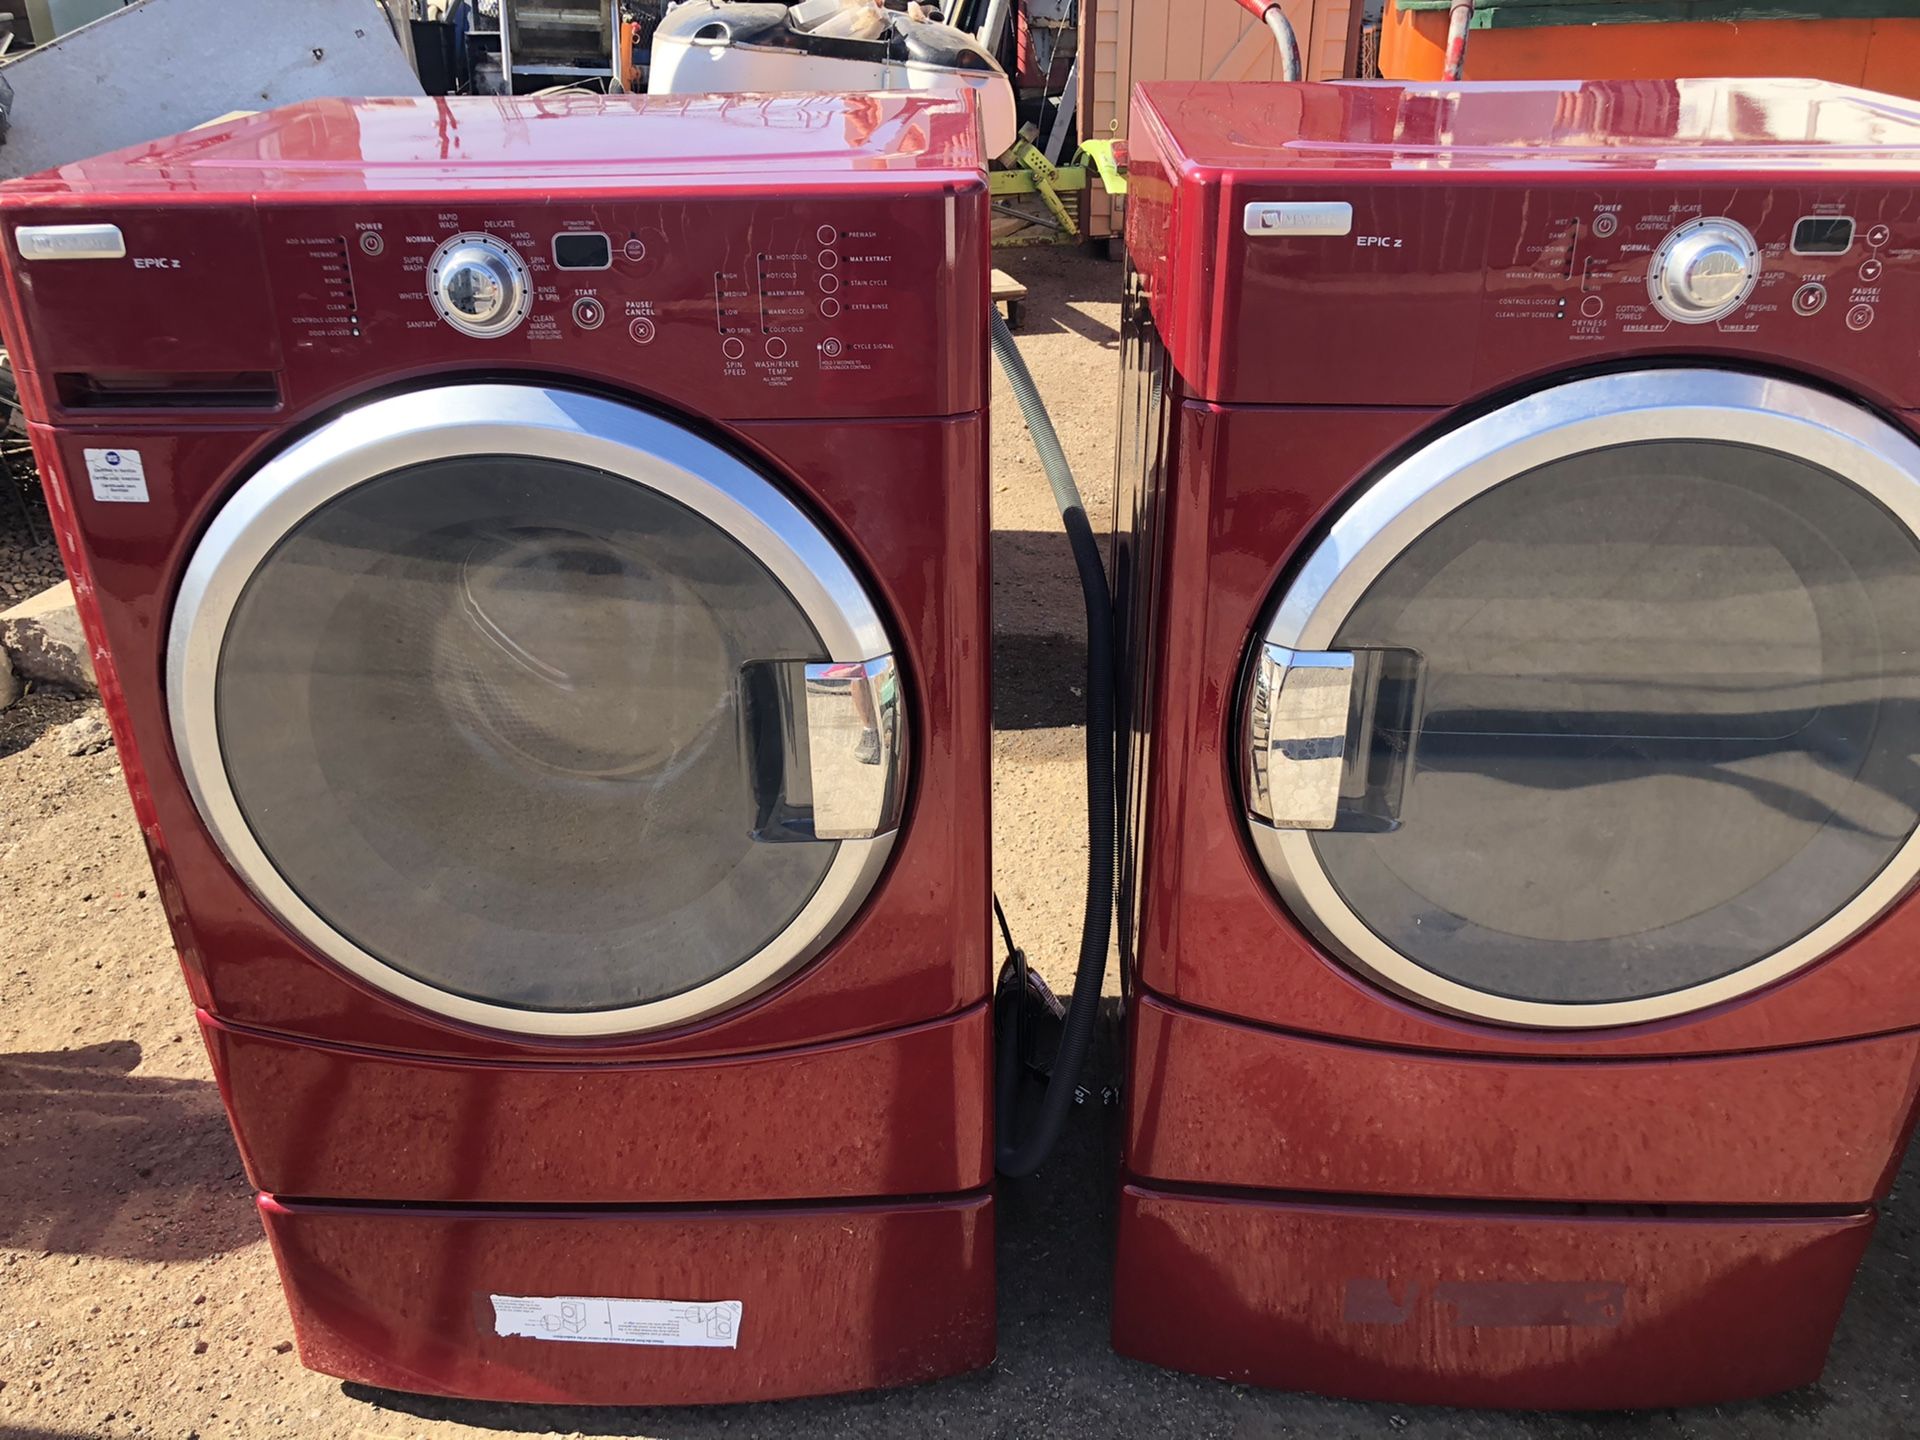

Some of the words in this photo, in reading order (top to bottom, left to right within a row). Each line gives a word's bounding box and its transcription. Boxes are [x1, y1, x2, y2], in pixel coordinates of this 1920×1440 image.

[1593, 204, 1622, 212] POWER
[1669, 204, 1702, 212] DELICATE
[484, 220, 516, 228] DELICATE
[1636, 222, 1669, 230] CONTROL
[406, 236, 436, 244] NORMAL
[511, 232, 530, 240] HAND
[1357, 236, 1391, 247] EPIC
[133, 258, 170, 269] EPIC
[403, 256, 424, 264] SUPER
[530, 256, 545, 264] SPIN
[532, 264, 550, 272] ONLY
[1802, 274, 1826, 282] START
[399, 292, 424, 300] WHITES
[1747, 304, 1778, 312] FRESHEN
[529, 322, 557, 330] WASHER
[1576, 326, 1600, 334] LEVEL
[754, 360, 800, 368] WASH/RINSE
[724, 368, 746, 376] SPEED
